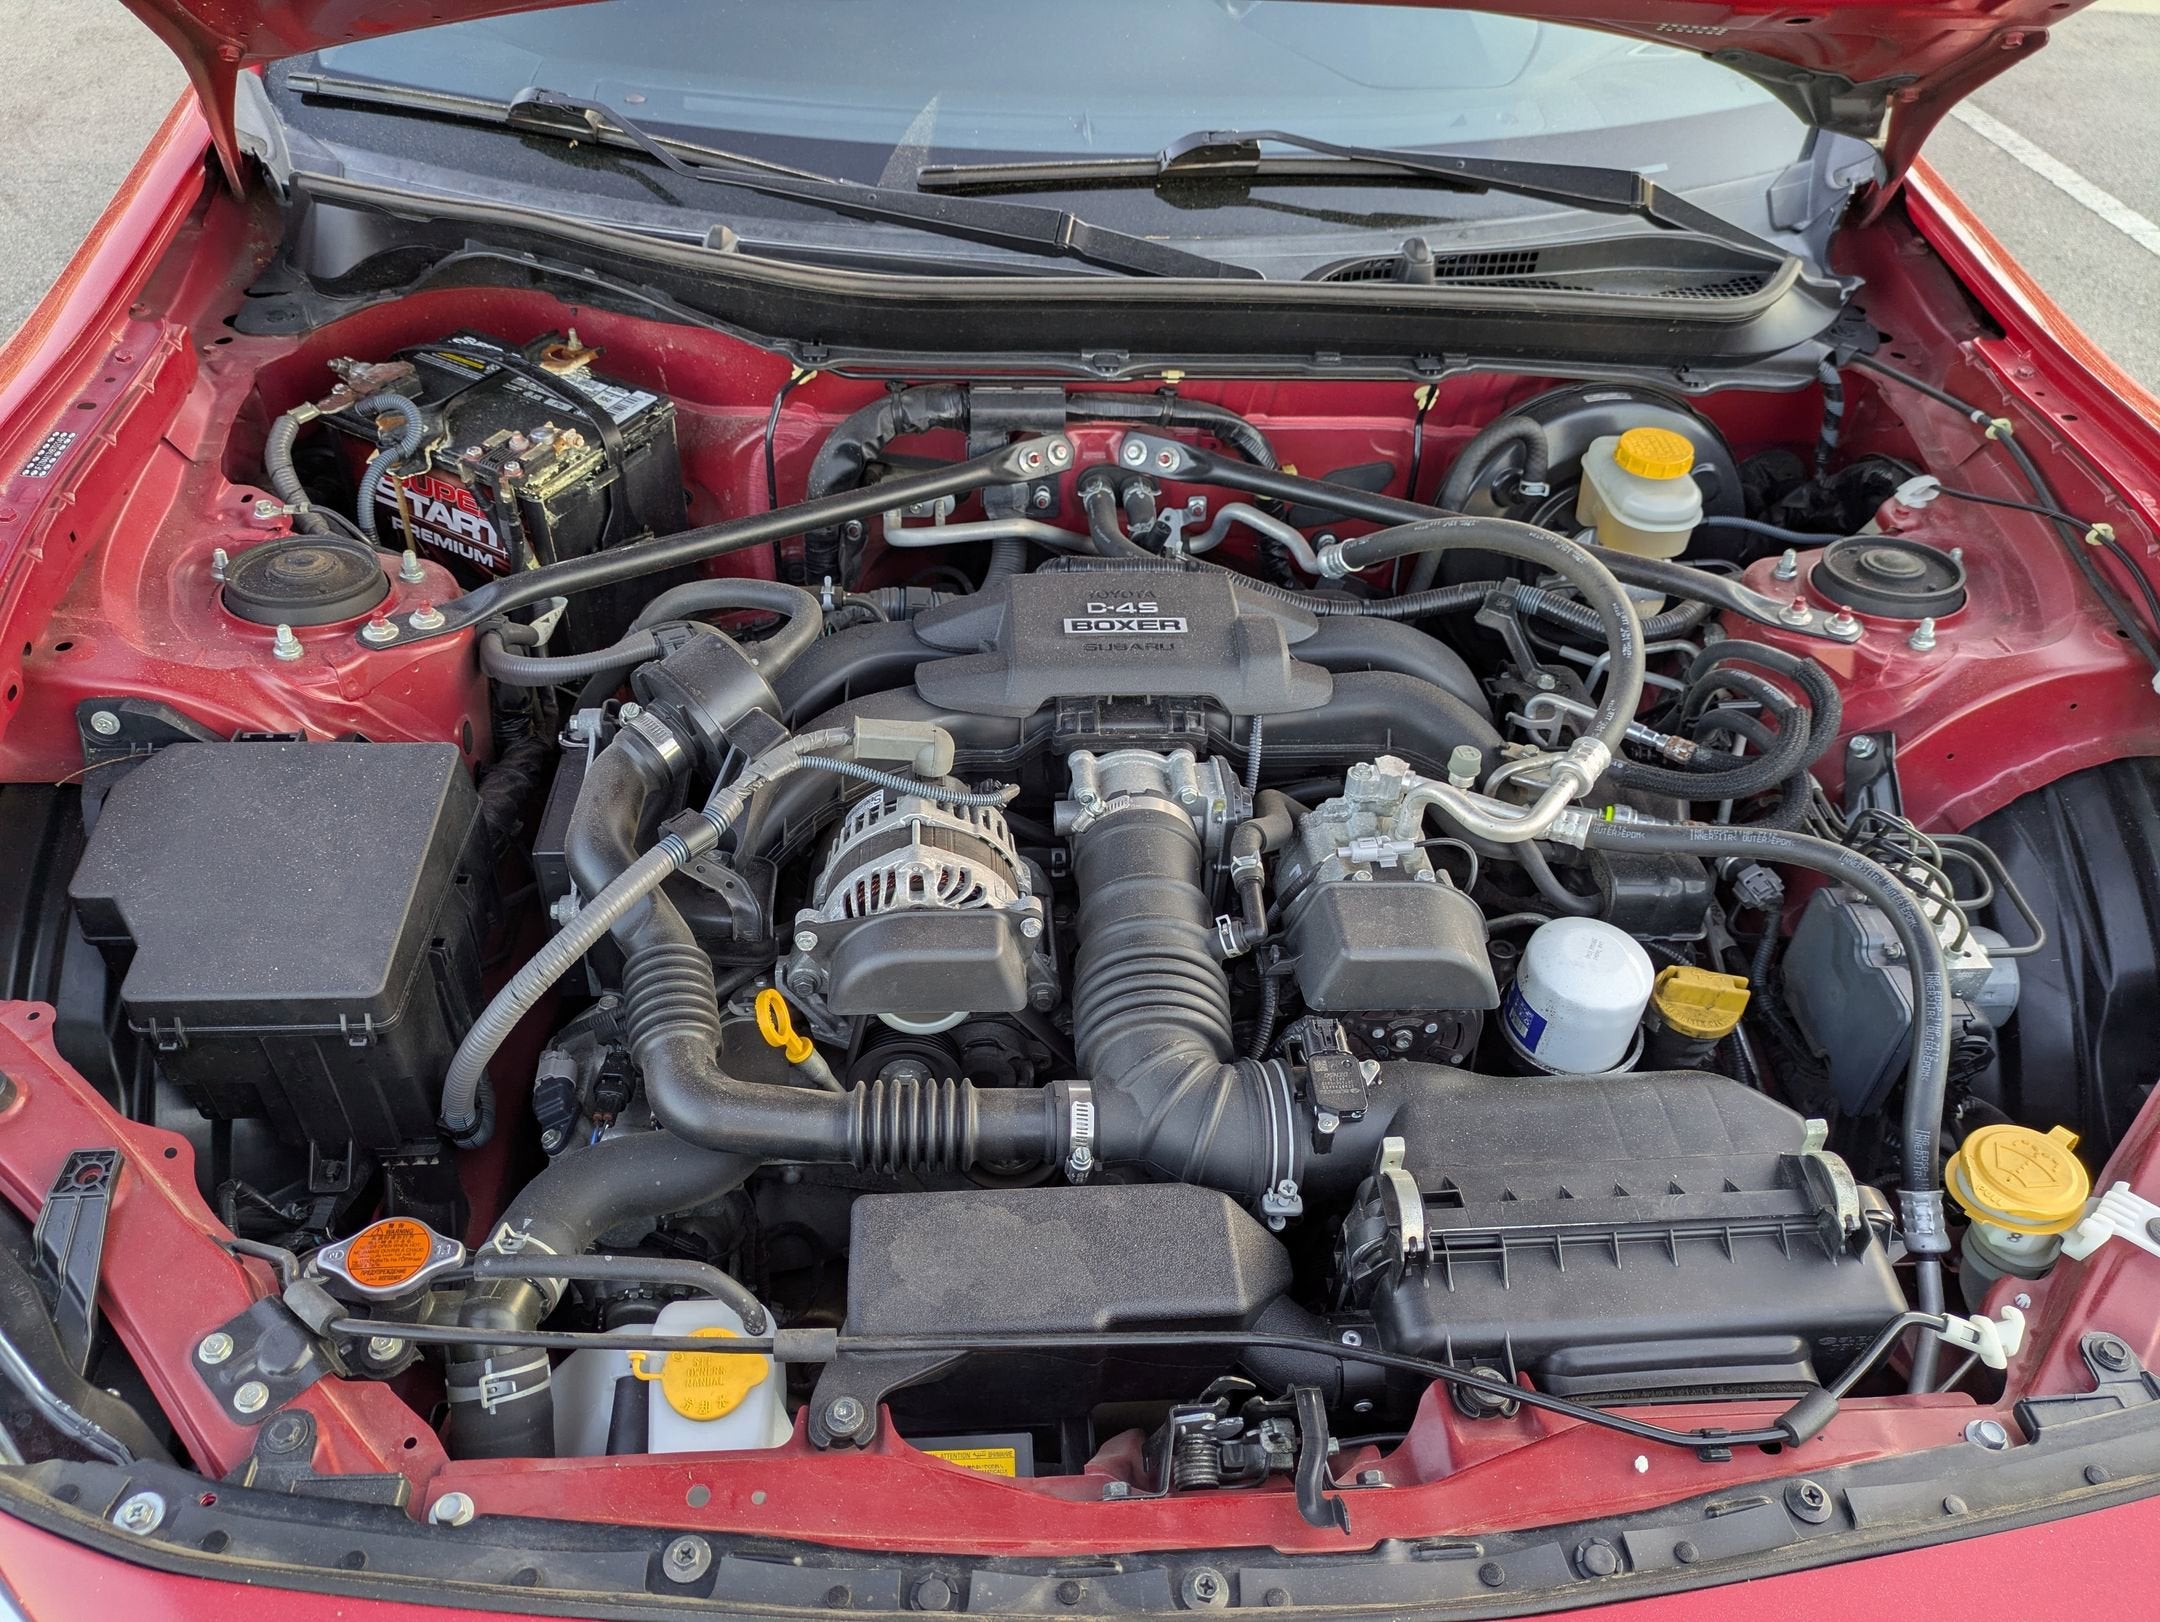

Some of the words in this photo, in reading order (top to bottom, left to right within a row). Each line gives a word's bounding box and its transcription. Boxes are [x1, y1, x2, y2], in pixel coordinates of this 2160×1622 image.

[1088, 590, 1157, 599] TOYOTA
[1087, 602, 1159, 614] D-4S
[1071, 620, 1182, 631] BOXER
[1082, 643, 1175, 652] SUBARU
